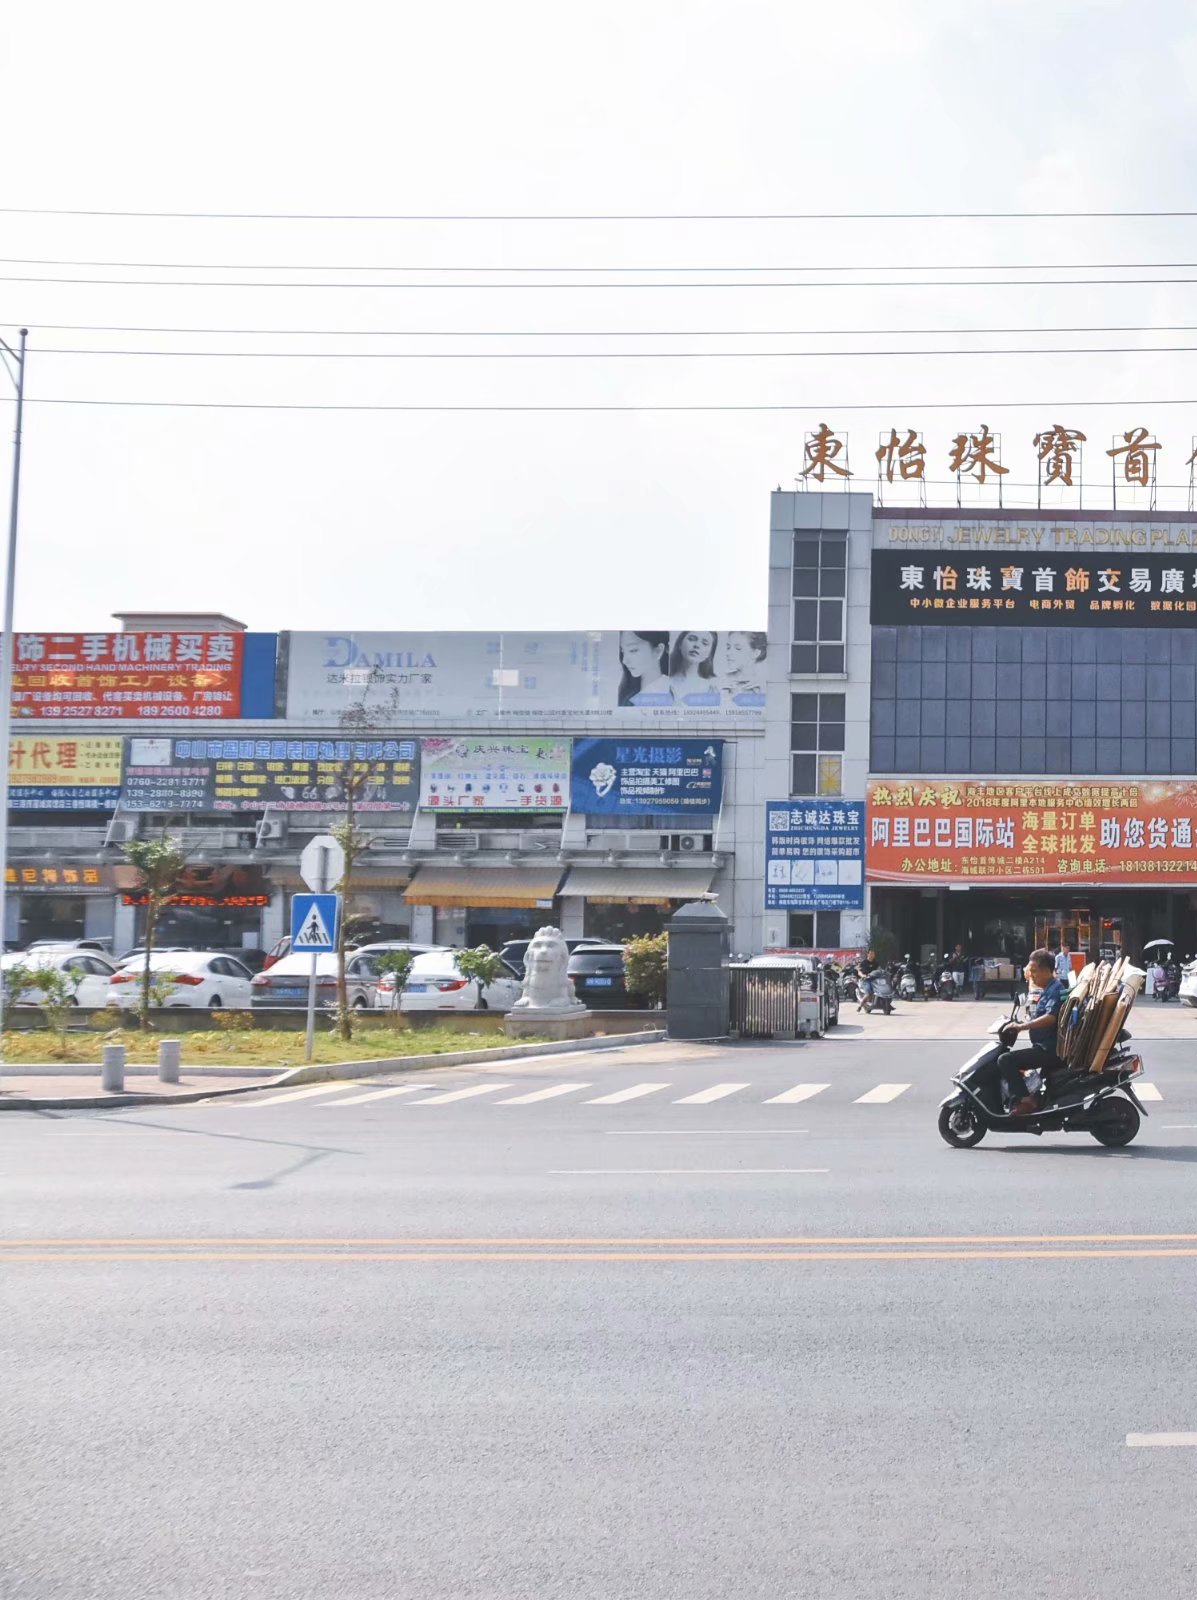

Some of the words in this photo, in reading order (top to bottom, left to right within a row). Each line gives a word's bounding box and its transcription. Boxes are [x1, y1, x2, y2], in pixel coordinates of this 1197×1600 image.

[947, 527, 1045, 545] JEWELRY
[1051, 528, 1147, 546] TRADING
[910, 598, 1016, 609] 中小微企业服务平台
[1029, 599, 1076, 610] 电商外贸
[1089, 600, 1136, 611] 品牌孵化
[40, 664, 84, 672] SECOND
[86, 664, 116, 672] HAND
[118, 664, 182, 672] MACHINERY
[184, 664, 232, 672] TRADING
[505, 795, 562, 806] 一手货源
[872, 786, 963, 808] 热烈庆祝
[790, 809, 860, 826] 志诚达珠宝
[1021, 811, 1097, 831] 海量订单
[871, 817, 1016, 849] 阿里巴巴国际站
[1021, 834, 1097, 855] 全球批发
[1057, 858, 1112, 874] 咨询电话：
